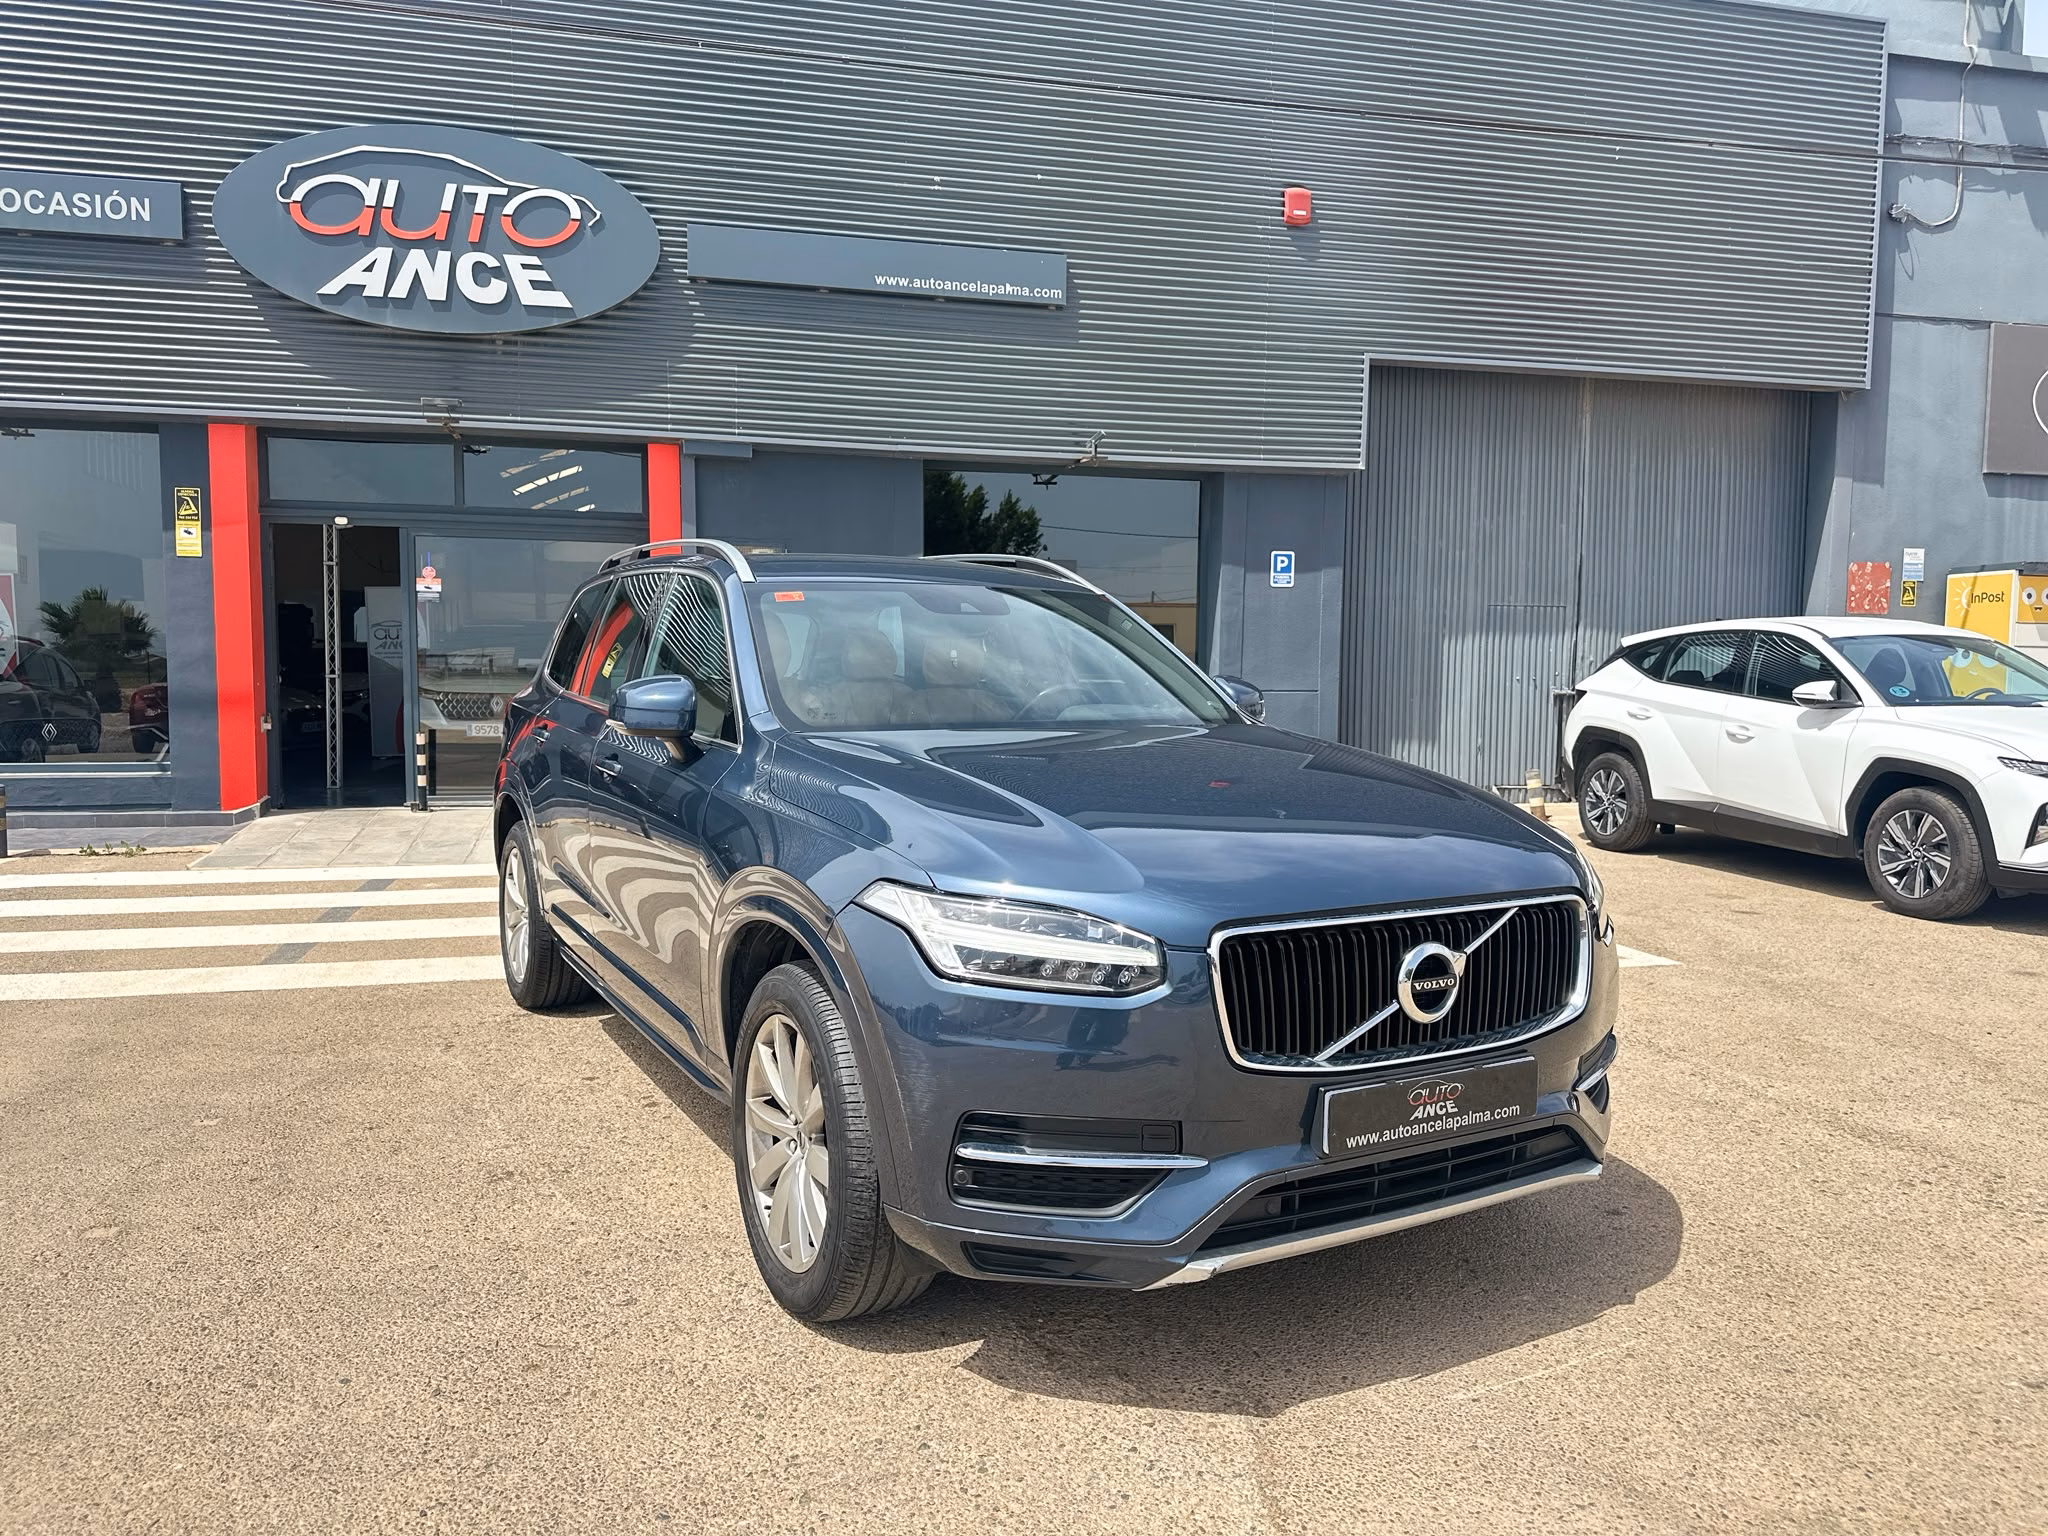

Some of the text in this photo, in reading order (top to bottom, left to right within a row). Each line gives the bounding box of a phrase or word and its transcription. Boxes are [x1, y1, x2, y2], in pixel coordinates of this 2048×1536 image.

[0, 187, 151, 222] OCASIÓN
[316, 246, 573, 309] ANCE
[874, 273, 1063, 299] www.autoancelapalma.com
[1276, 555, 1289, 572] P
[1970, 590, 2006, 604] InPost
[374, 640, 403, 650] AN
[474, 724, 500, 735] 9578
[1413, 977, 1455, 991] VOLVO
[1409, 1099, 1459, 1121] ANCE
[1346, 1104, 1520, 1148] www.autoancelapalma.com
